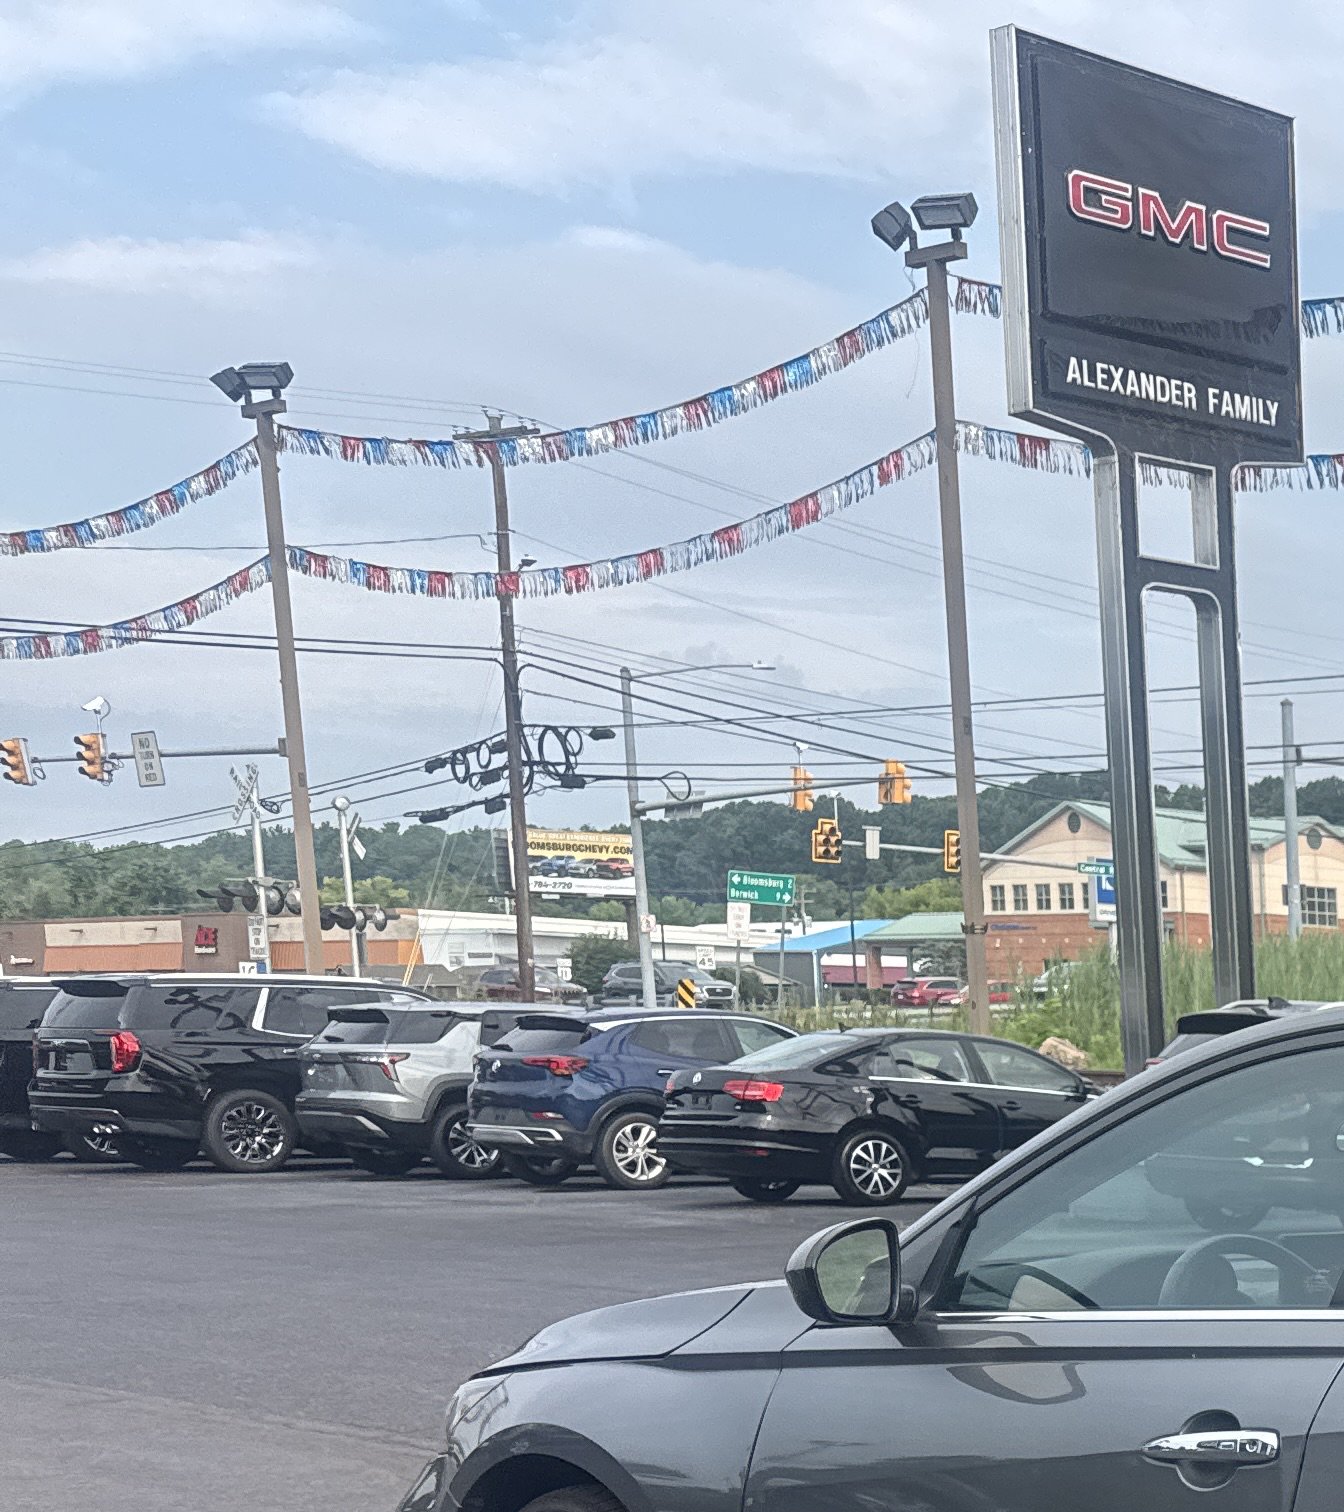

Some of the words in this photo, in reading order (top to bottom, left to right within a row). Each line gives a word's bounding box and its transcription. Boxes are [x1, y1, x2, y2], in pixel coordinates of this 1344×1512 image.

[1067, 169, 1271, 269] GMC
[1066, 356, 1198, 411] ALEXANDER
[1208, 387, 1279, 427] FAMILY
[138, 738, 150, 749] NO
[743, 875, 784, 889] Bloomsburg
[788, 879, 793, 888] 2
[731, 888, 759, 899] Berwick
